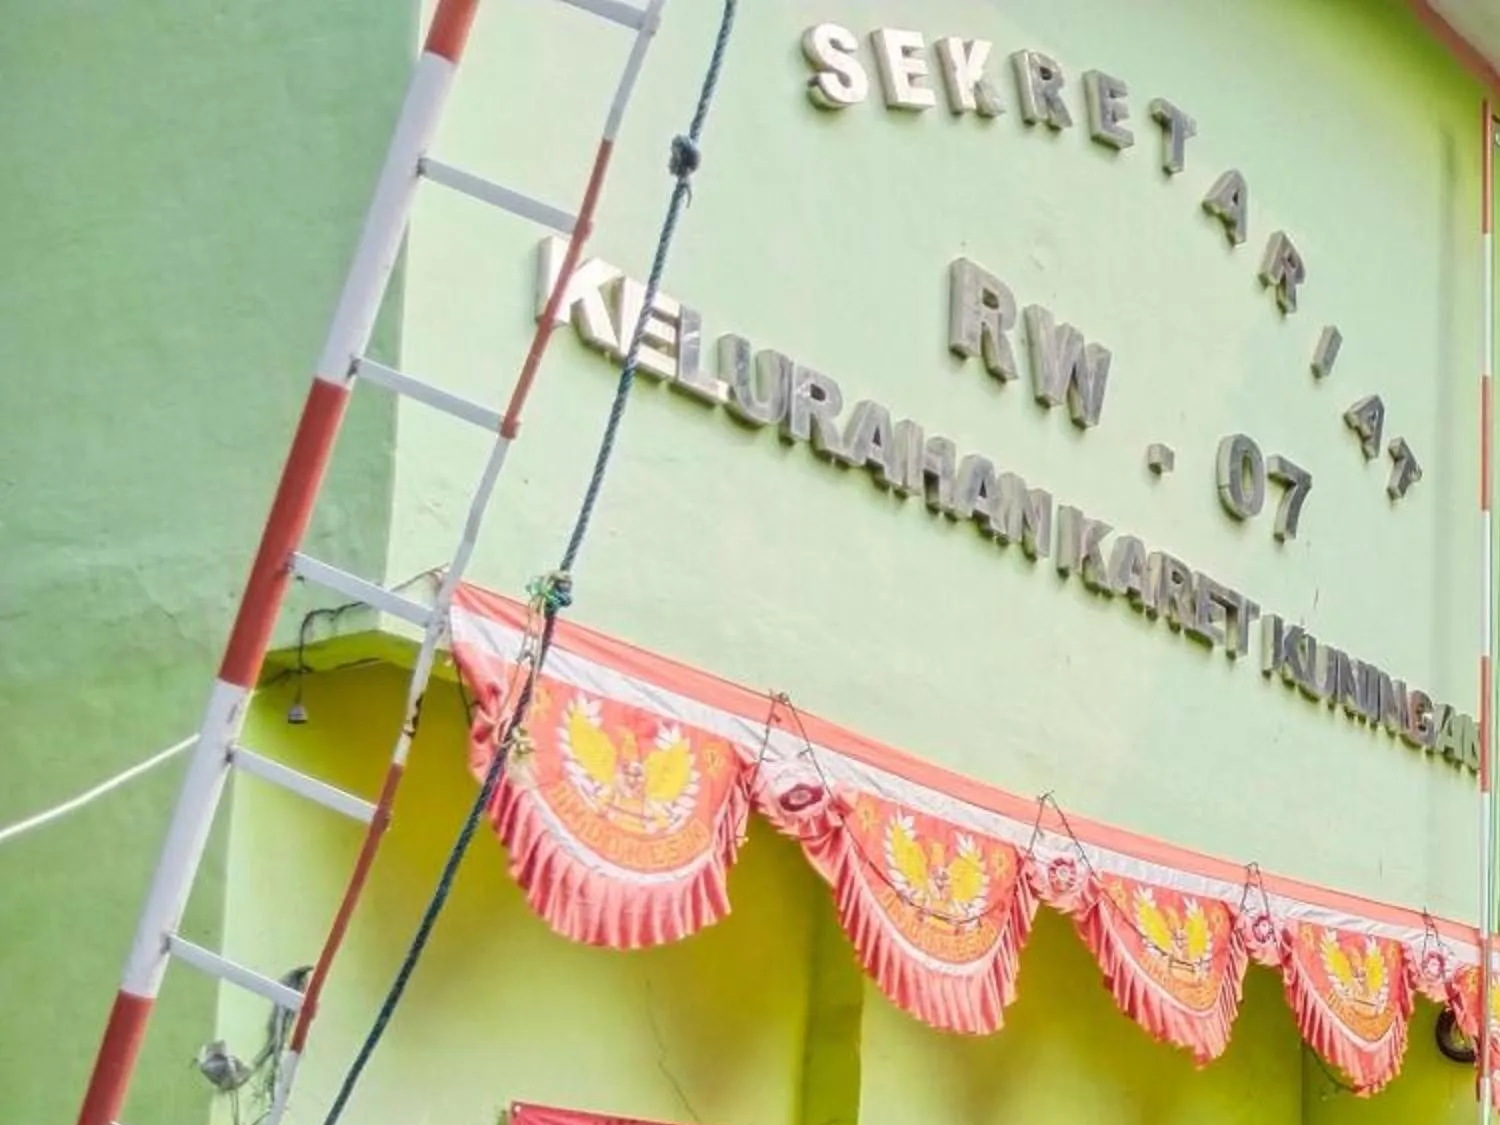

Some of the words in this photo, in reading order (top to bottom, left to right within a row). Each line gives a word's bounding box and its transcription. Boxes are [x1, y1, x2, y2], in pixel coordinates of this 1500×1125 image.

[535, 234, 1054, 563] KELURAHAN
[1057, 503, 1260, 662] KARET
[803, 22, 1424, 504] SEKRETARIAT
[946, 257, 1113, 430] RW
[1216, 433, 1313, 543] 07
